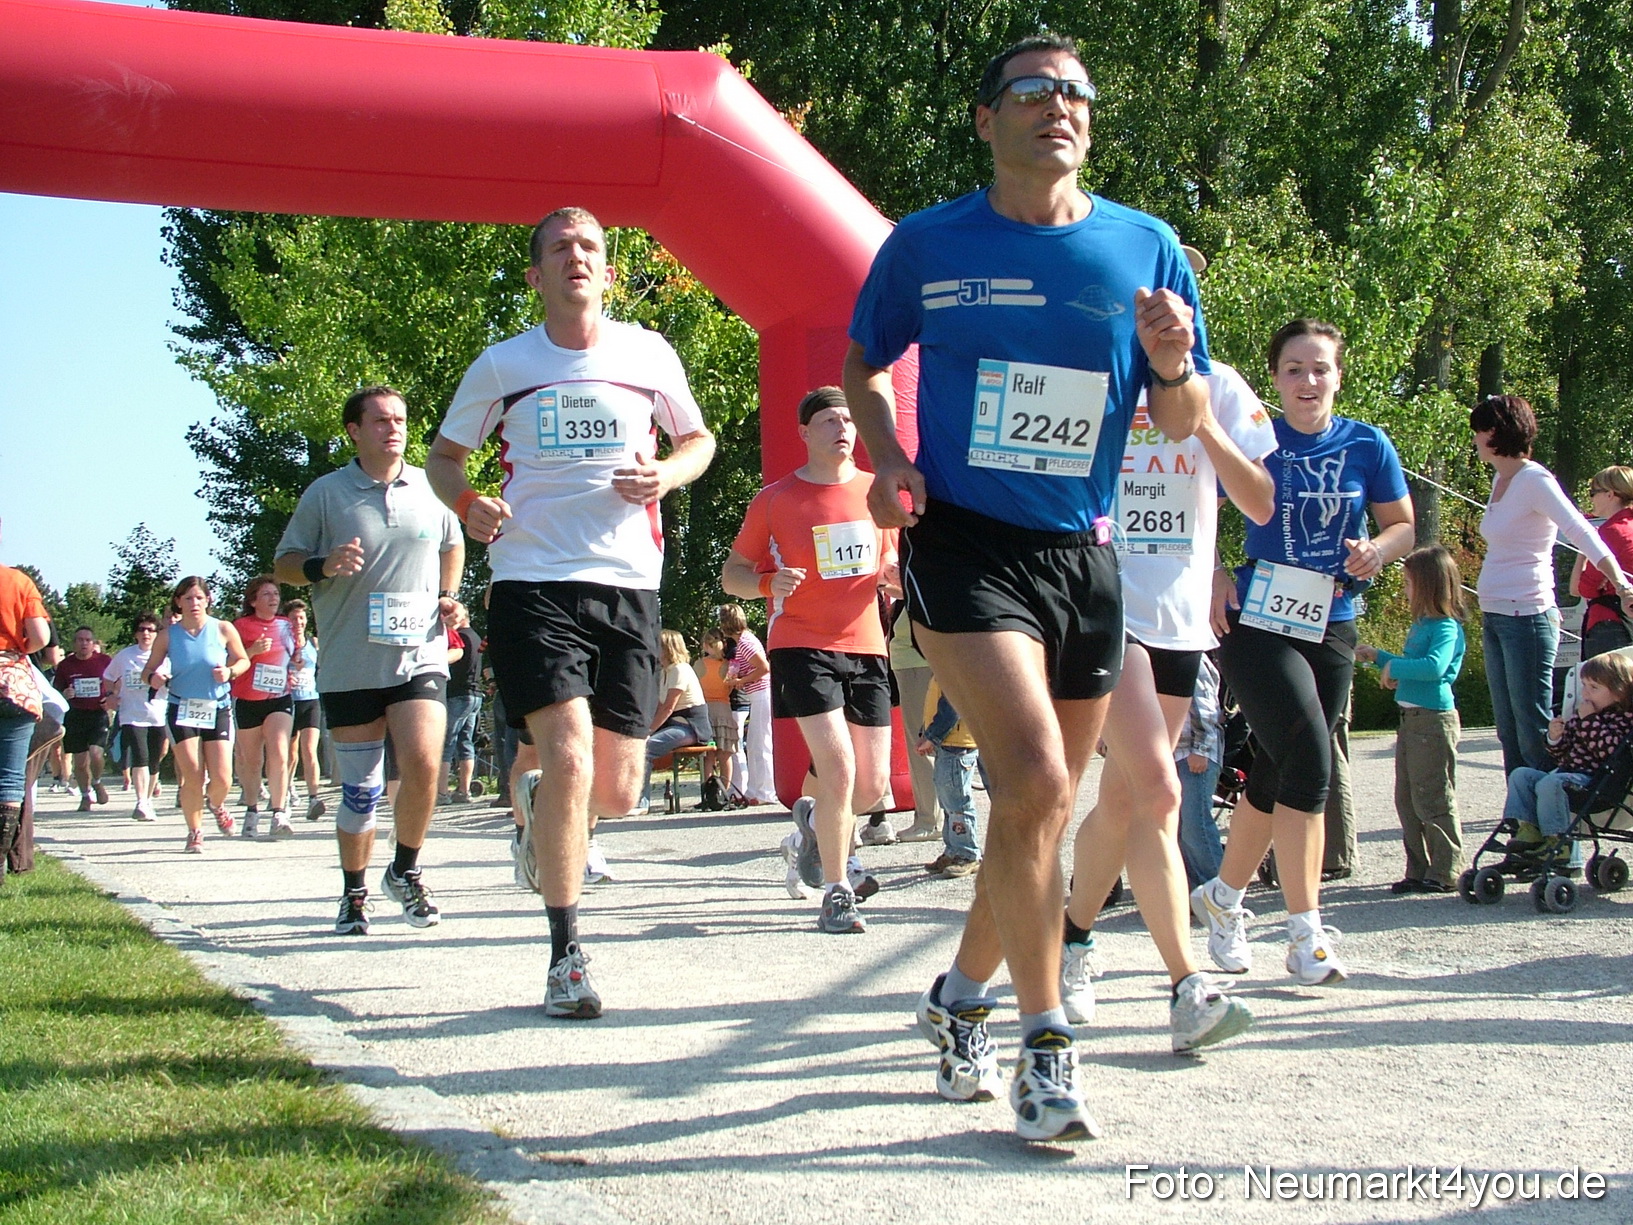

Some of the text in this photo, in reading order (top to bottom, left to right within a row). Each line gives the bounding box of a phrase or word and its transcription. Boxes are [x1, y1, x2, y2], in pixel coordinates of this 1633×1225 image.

[1012, 373, 1047, 395] Ralf
[561, 395, 597, 409] Dieter
[979, 401, 988, 416] D
[565, 419, 618, 440] 3391
[1009, 412, 1091, 447] 2242
[1123, 480, 1166, 500] Margit
[1126, 510, 1185, 533] 2681
[835, 544, 871, 561] 1171
[387, 597, 411, 608] Oliver
[1269, 594, 1324, 623] 3745
[388, 616, 424, 631] 3484
[263, 676, 284, 687] 2432
[188, 711, 213, 721] 3221
